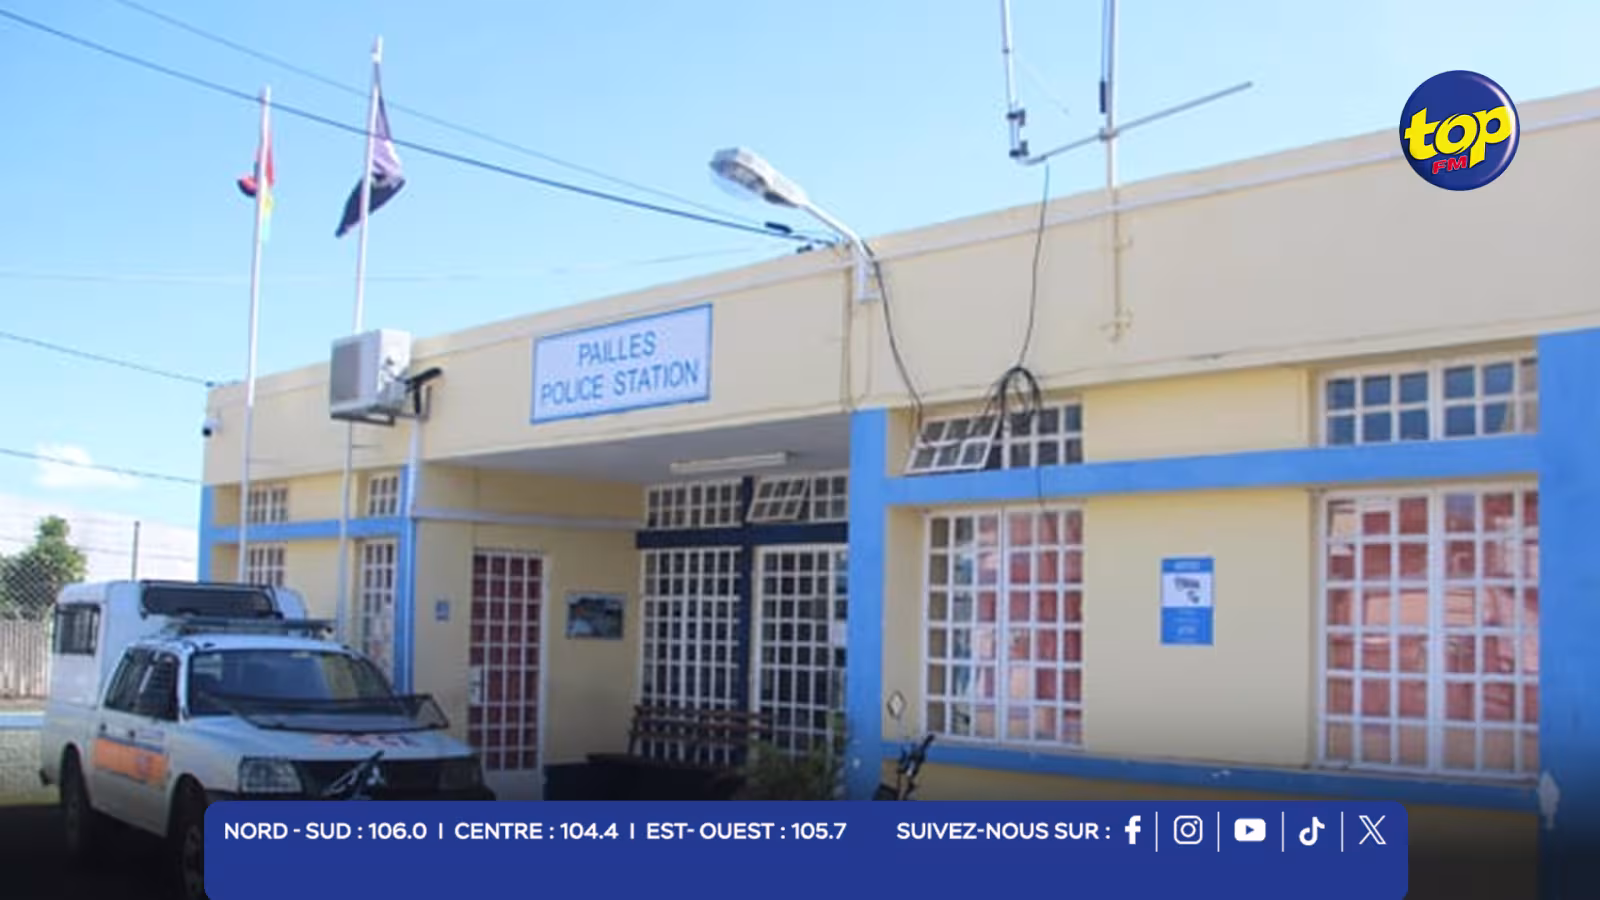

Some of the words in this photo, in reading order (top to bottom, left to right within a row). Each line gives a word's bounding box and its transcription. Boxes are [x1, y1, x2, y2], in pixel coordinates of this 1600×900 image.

[578, 331, 656, 367] PAILLES
[541, 375, 604, 406] POLICE
[613, 359, 699, 396] STATION
